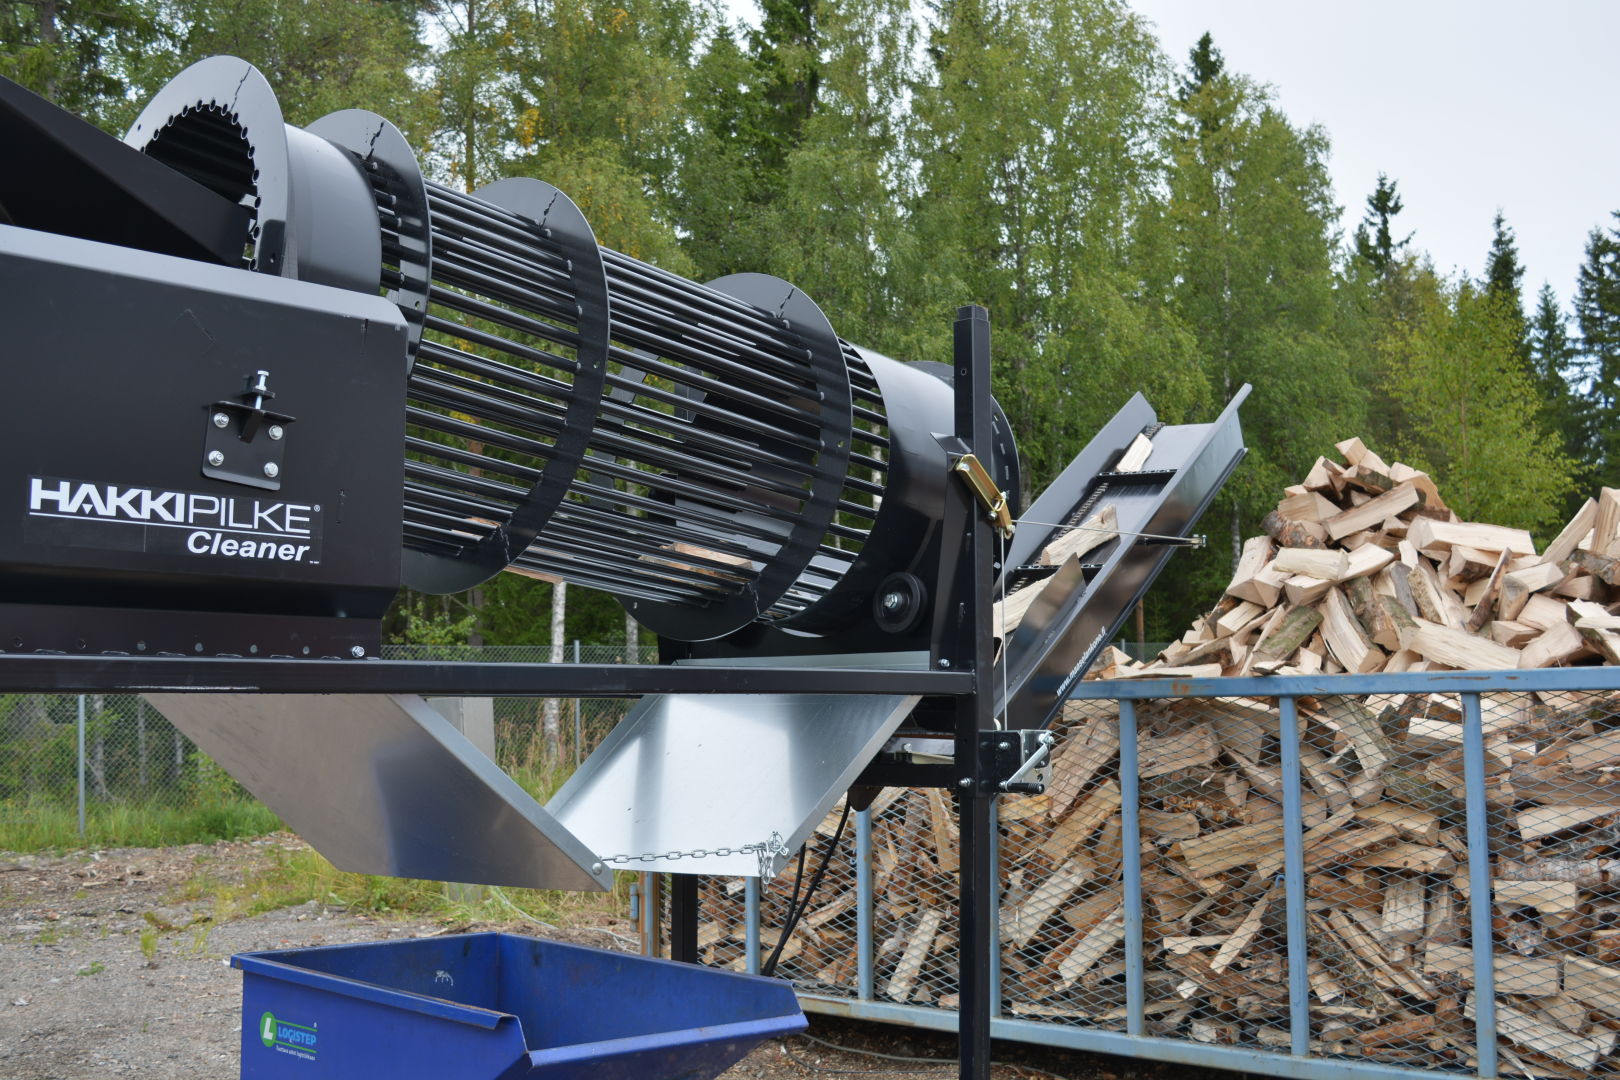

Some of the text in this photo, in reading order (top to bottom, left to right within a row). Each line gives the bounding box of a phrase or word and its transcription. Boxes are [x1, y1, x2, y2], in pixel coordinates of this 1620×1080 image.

[187, 530, 311, 562] Cleaner
[263, 1017, 274, 1040] L
[278, 1025, 317, 1046] LOGISTEP
